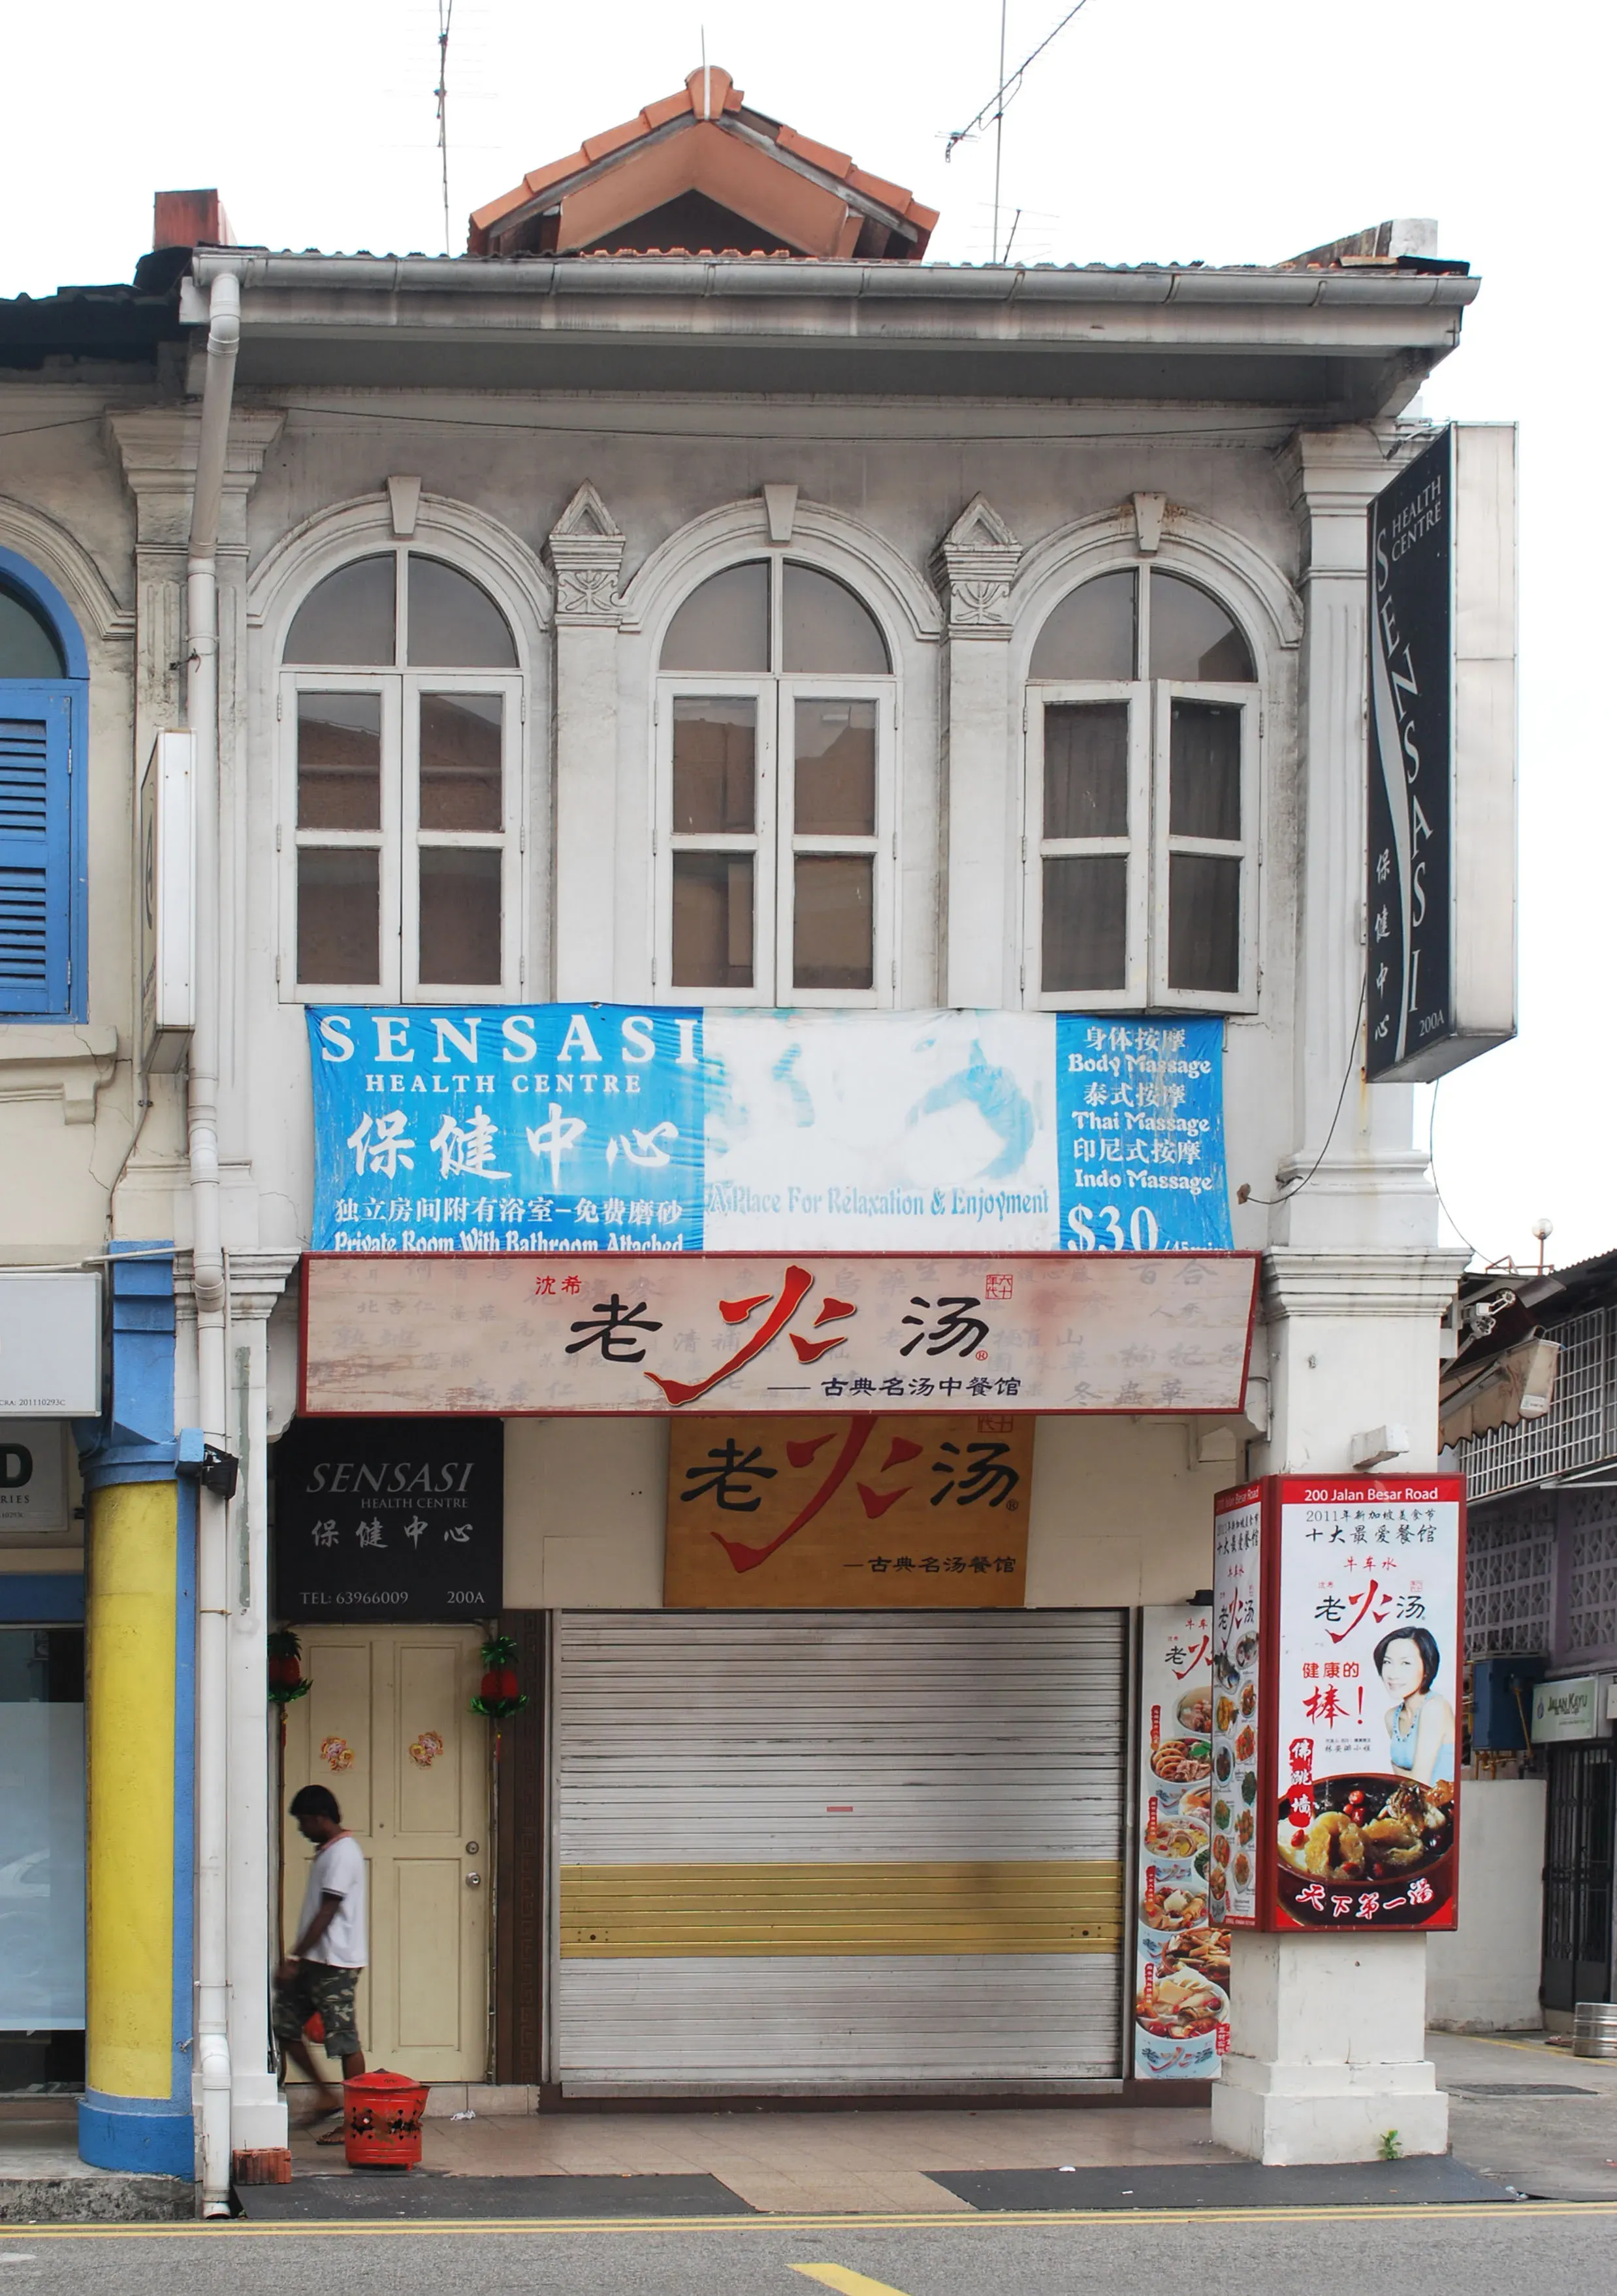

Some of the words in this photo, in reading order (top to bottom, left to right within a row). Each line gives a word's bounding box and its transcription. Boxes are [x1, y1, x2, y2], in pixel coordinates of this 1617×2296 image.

[1392, 476, 1441, 538] HEALTH
[1392, 501, 1441, 562] CENTRE
[1375, 528, 1433, 1012] SENSASI
[1374, 849, 1391, 1041] 保健中心
[1418, 1009, 1445, 1037] 200A
[320, 1014, 699, 1063] SENSASI
[1084, 1026, 1187, 1052] 身体按摩
[1068, 1053, 1121, 1078] Body
[1126, 1054, 1212, 1079] Massage
[366, 1074, 495, 1093] HEALTH
[512, 1074, 641, 1093] CENTRE
[1083, 1082, 1187, 1108] 泰式按摩
[1072, 1110, 1119, 1131] Thai
[1125, 1112, 1210, 1137] Massage
[347, 1103, 679, 1190] 保健中心
[1073, 1138, 1202, 1165] 印尼式按摩
[1074, 1169, 1122, 1188] Indo
[1126, 1169, 1213, 1195] Massage
[731, 1186, 781, 1215] Place
[787, 1186, 822, 1214] For
[827, 1186, 923, 1216] Relaxation
[930, 1188, 946, 1215] &
[951, 1186, 1049, 1222] Enjoyment
[334, 1231, 395, 1251] Private
[402, 1229, 455, 1251] Room
[460, 1228, 500, 1251] With
[505, 1229, 598, 1251] Bathroom
[607, 1231, 683, 1251] Attached
[535, 1275, 583, 1295] 沈希
[565, 1265, 991, 1406] 老火汤
[306, 1463, 475, 1493] SENSASI
[361, 1498, 412, 1508] HEALTH
[417, 1498, 468, 1508] CENTRE
[680, 1416, 1020, 1574] 老火汤
[1304, 1489, 1328, 1502] 200
[1331, 1489, 1364, 1502] Jalan
[1368, 1488, 1402, 1501] Besar
[1405, 1487, 1439, 1500] Road
[312, 1515, 473, 1550] 保健中心
[1306, 1524, 1437, 1544] 十大最爱餐馆
[1343, 1555, 1398, 1572] 牛车水
[300, 1591, 331, 1604] TEL:
[336, 1591, 409, 1604] 63966009
[447, 1591, 485, 1604] 200A
[1314, 1578, 1426, 1644] 老火汤
[1303, 1662, 1360, 1679] 健康的
